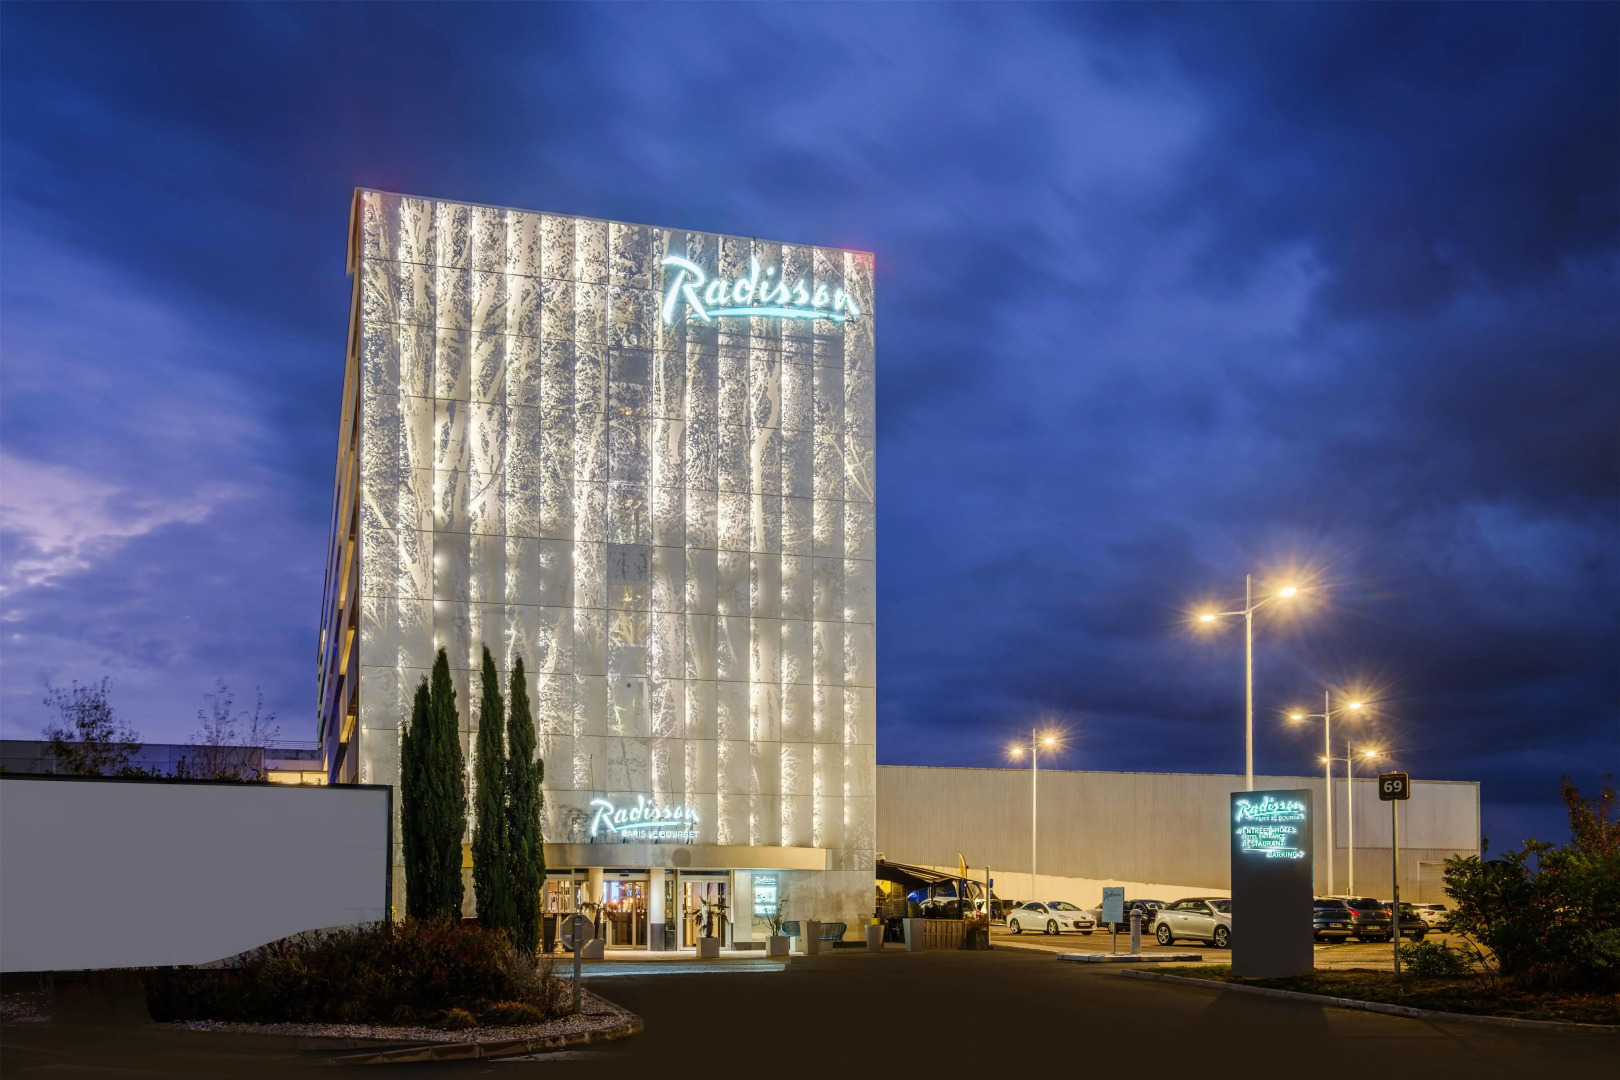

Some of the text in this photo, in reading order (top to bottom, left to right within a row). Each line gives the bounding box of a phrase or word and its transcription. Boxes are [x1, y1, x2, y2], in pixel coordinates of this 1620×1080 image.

[661, 254, 860, 325] Radisson
[1384, 780, 1402, 792] 69
[590, 794, 700, 837] Radisson
[1236, 796, 1305, 821] Radisson
[622, 830, 699, 838] PARIS LE BOURGET
[1243, 840, 1285, 848] RESTAURANT
